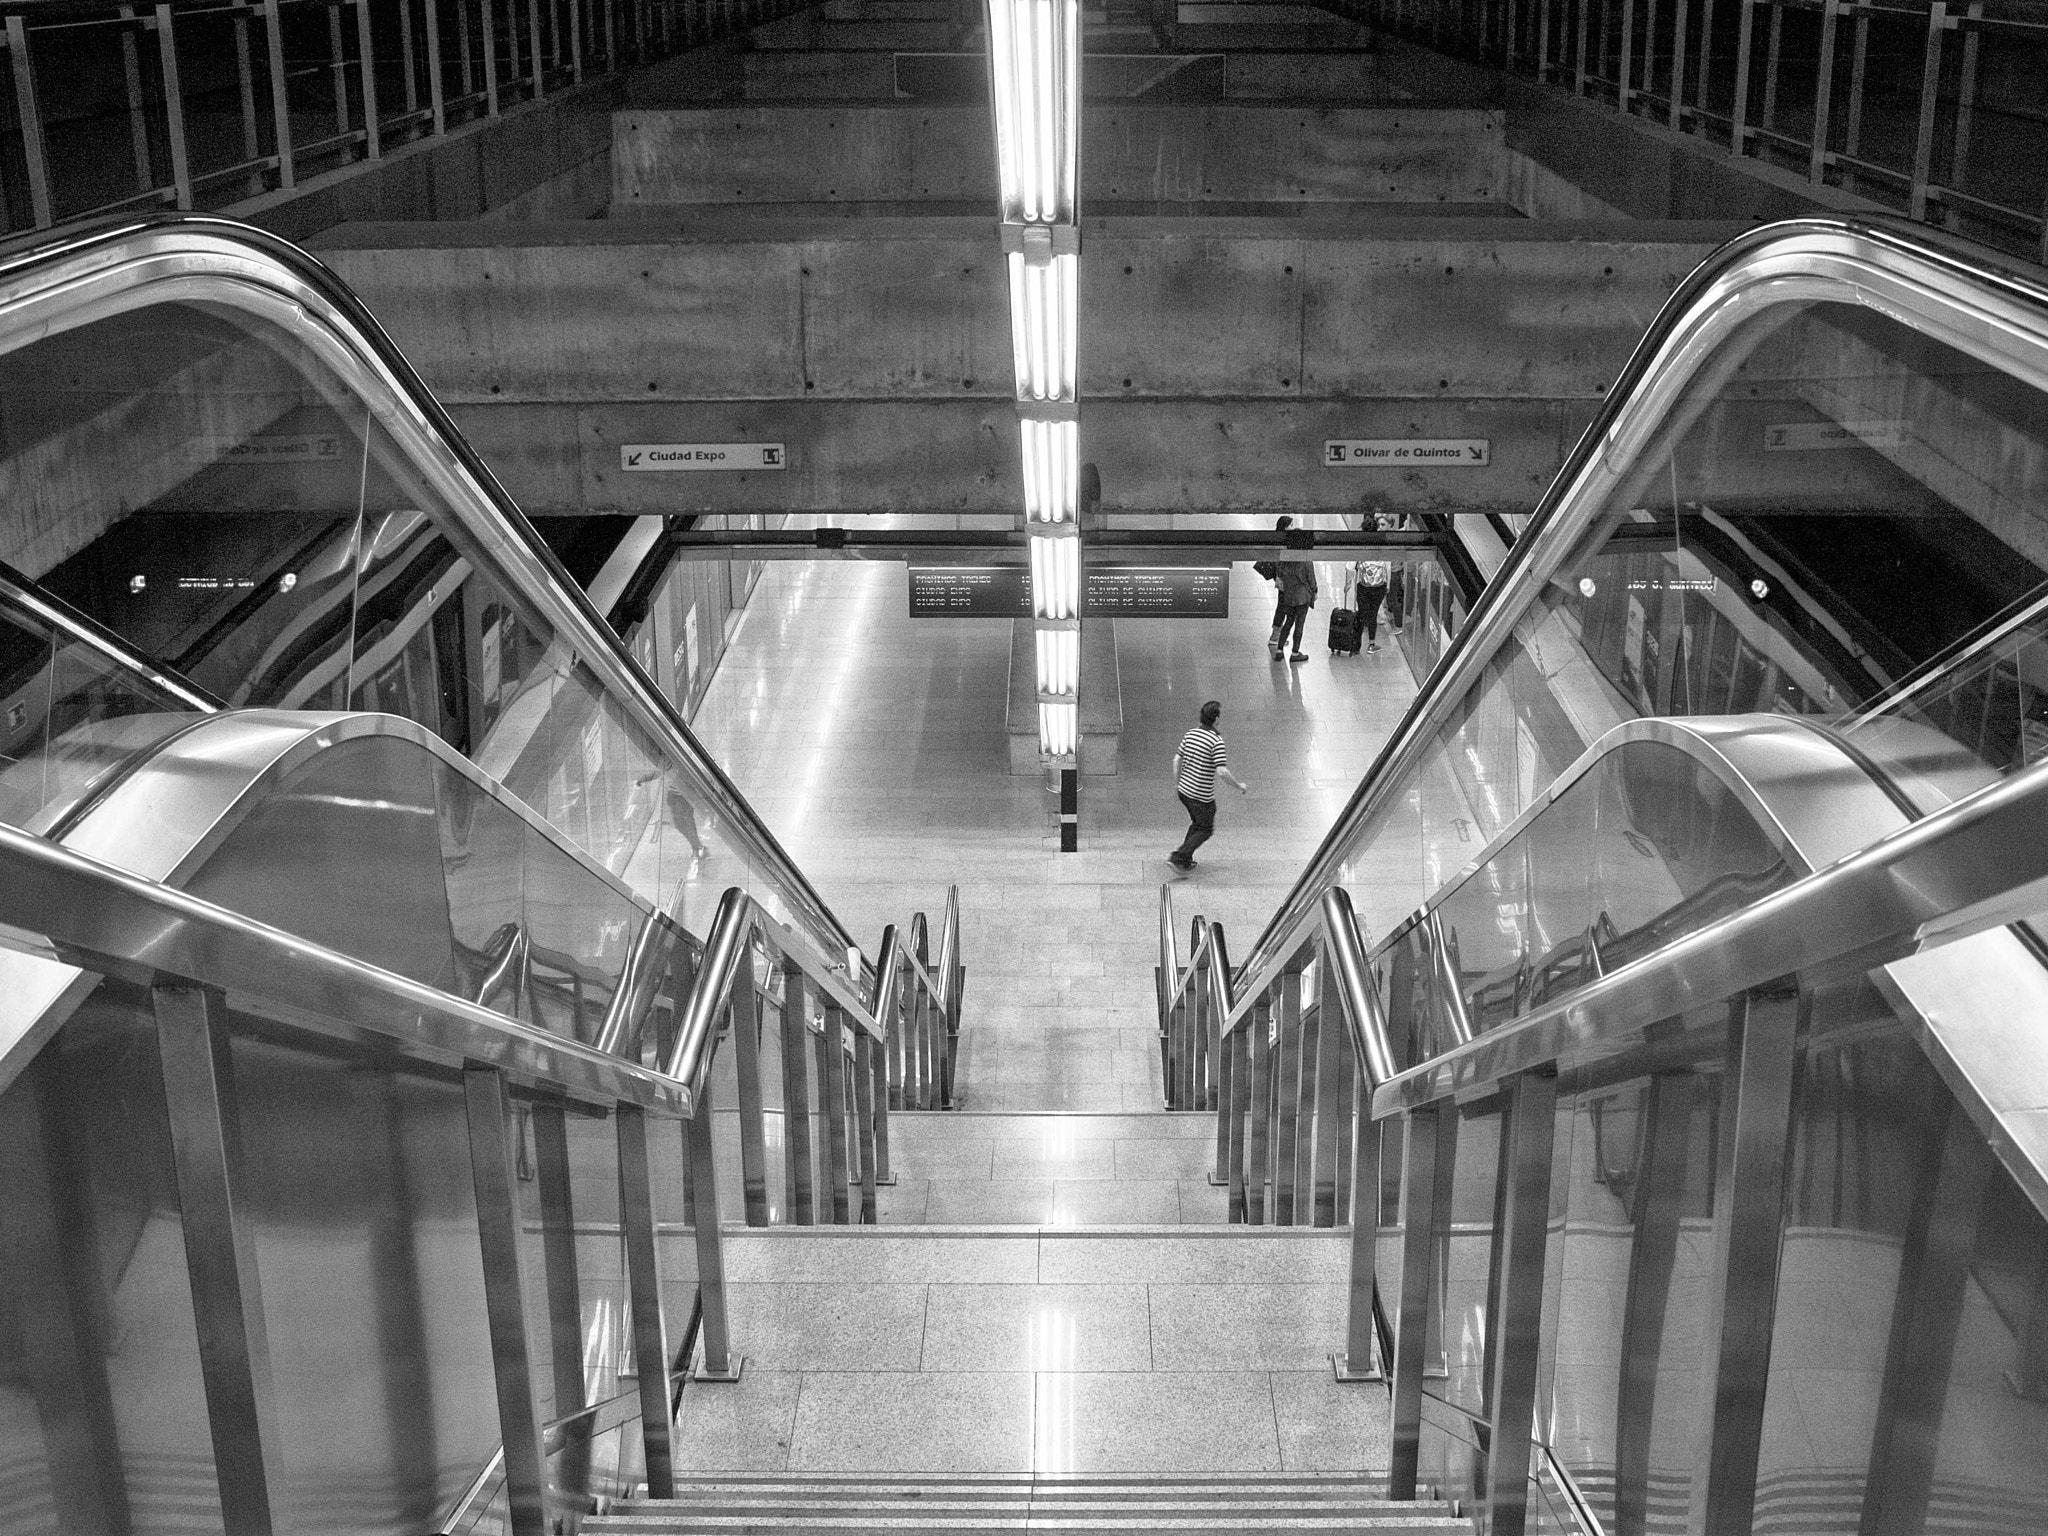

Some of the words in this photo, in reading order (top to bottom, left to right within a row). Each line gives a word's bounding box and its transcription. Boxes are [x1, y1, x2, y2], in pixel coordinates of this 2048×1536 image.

[649, 451, 692, 461] Ciudad
[695, 451, 726, 462] Expo
[1353, 447, 1390, 458] Olivar
[1394, 447, 1409, 458] de
[1413, 447, 1461, 458] Quintos
[915, 587, 946, 595] CIUDAD
[915, 598, 946, 606] CIUDAD
